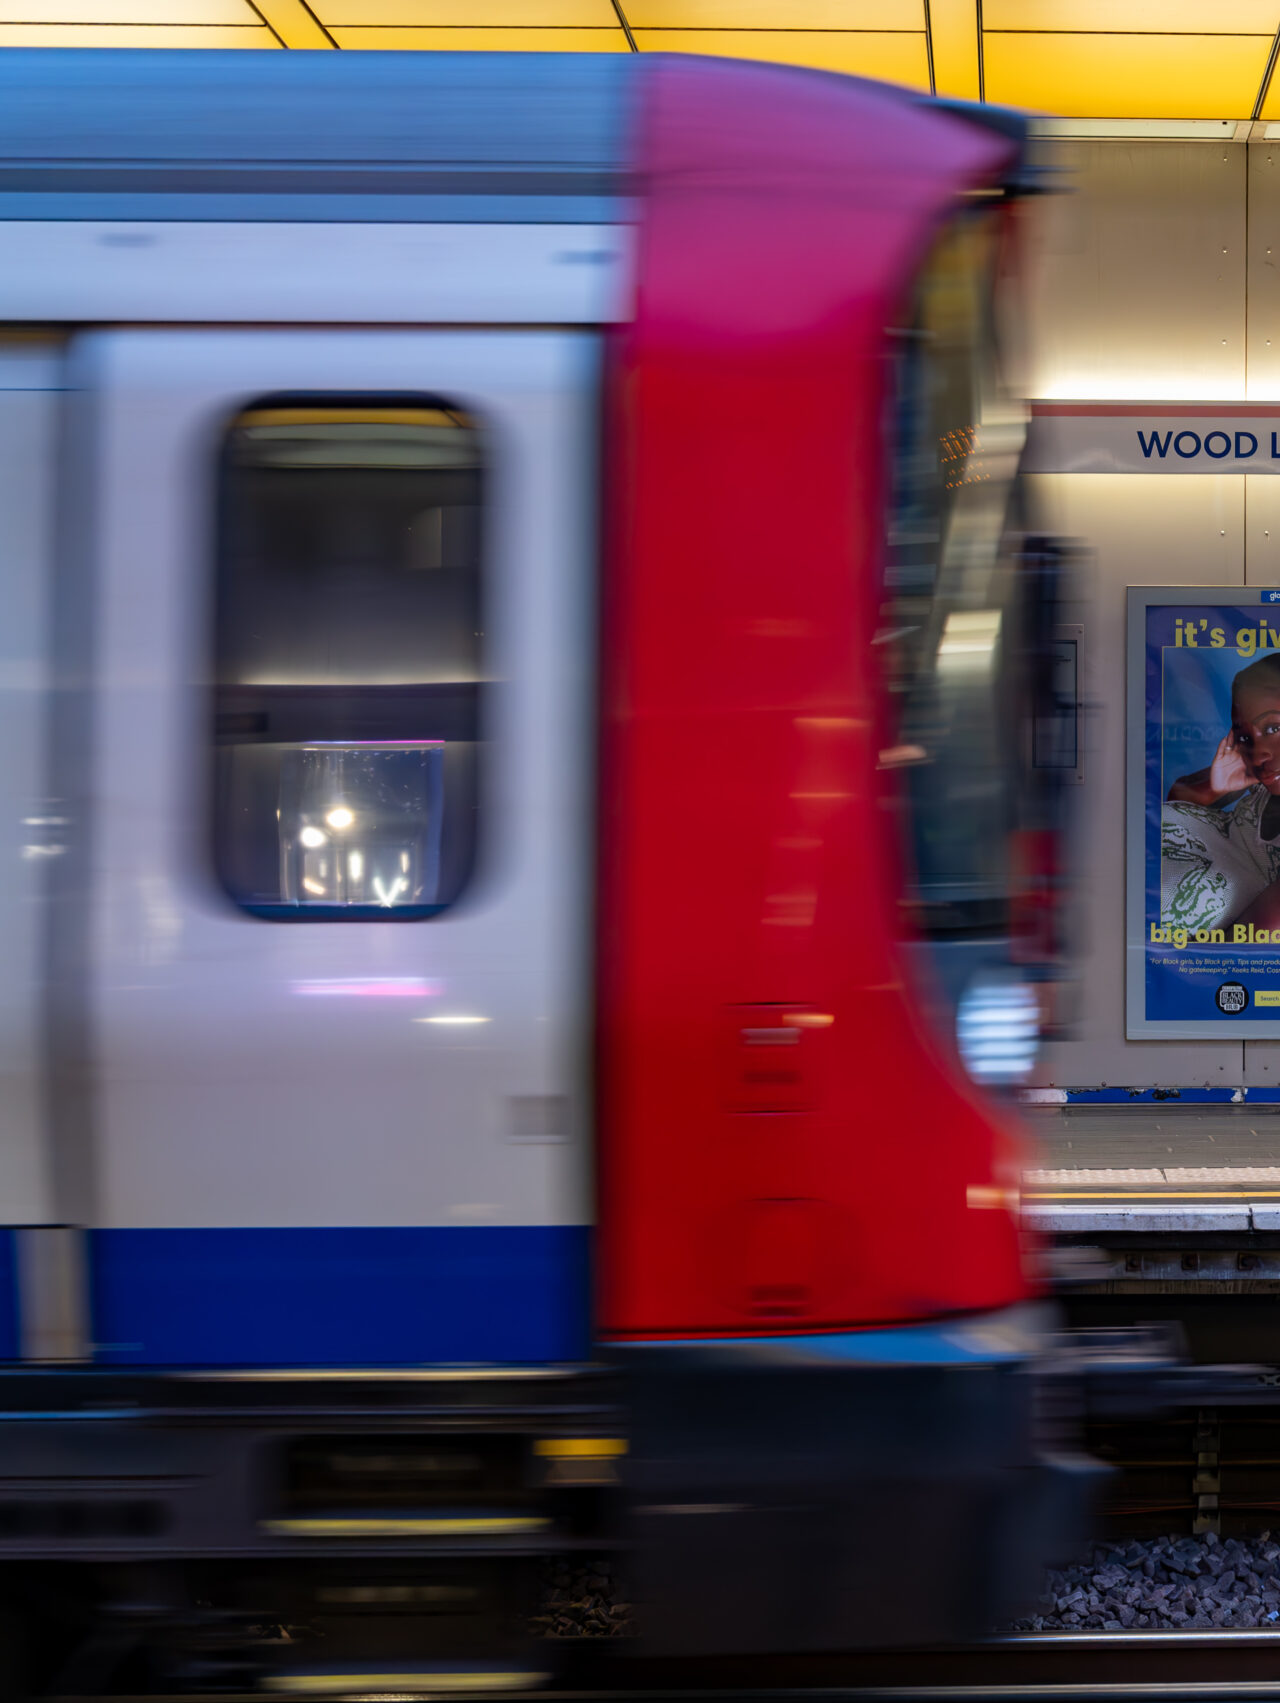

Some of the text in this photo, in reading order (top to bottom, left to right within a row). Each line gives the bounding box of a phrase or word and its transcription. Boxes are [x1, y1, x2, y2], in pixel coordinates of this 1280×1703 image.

[1136, 430, 1259, 459] WOOD
[1174, 619, 1226, 648] it's
[1150, 922, 1188, 949] big
[1195, 928, 1225, 944] on
[1163, 957, 1179, 965] Black
[1204, 957, 1220, 965] Black
[1237, 958, 1249, 967] Tips
